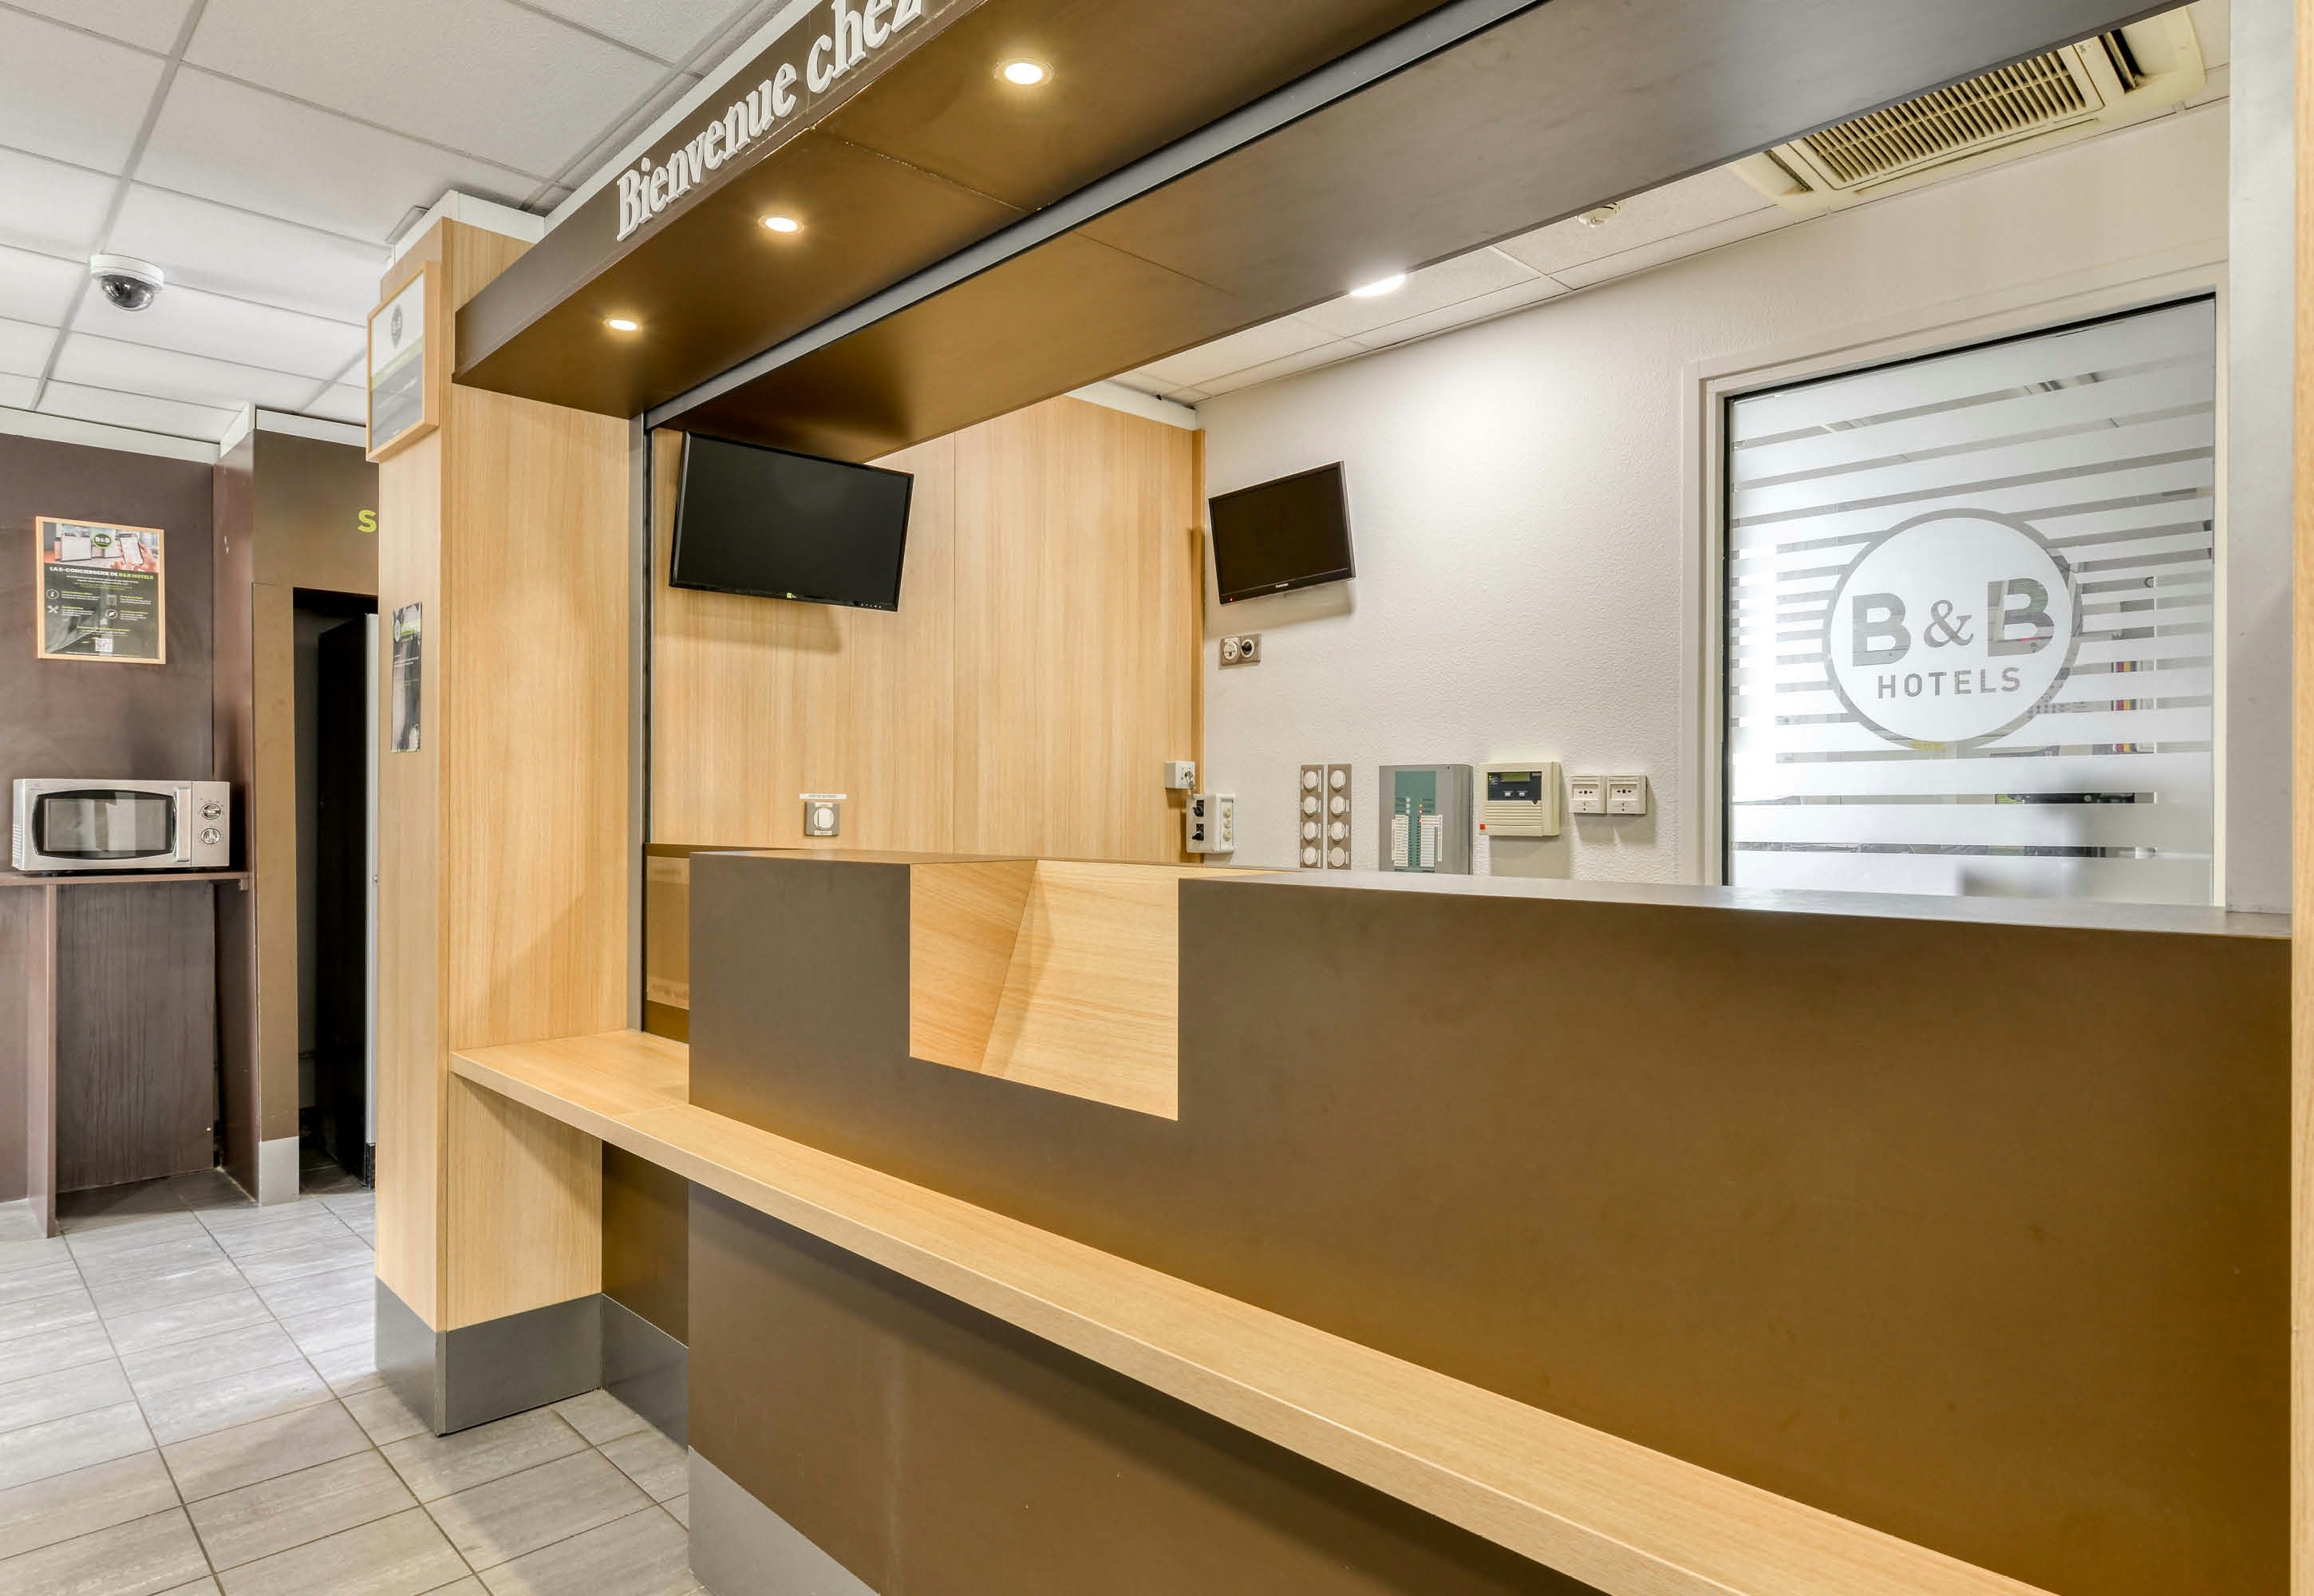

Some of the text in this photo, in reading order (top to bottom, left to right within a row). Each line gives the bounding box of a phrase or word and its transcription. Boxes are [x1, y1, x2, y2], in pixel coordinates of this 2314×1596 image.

[616, 63, 796, 242] Bienvenue
[1852, 578, 2055, 667] B&B
[1878, 667, 2021, 699] HOTELS
